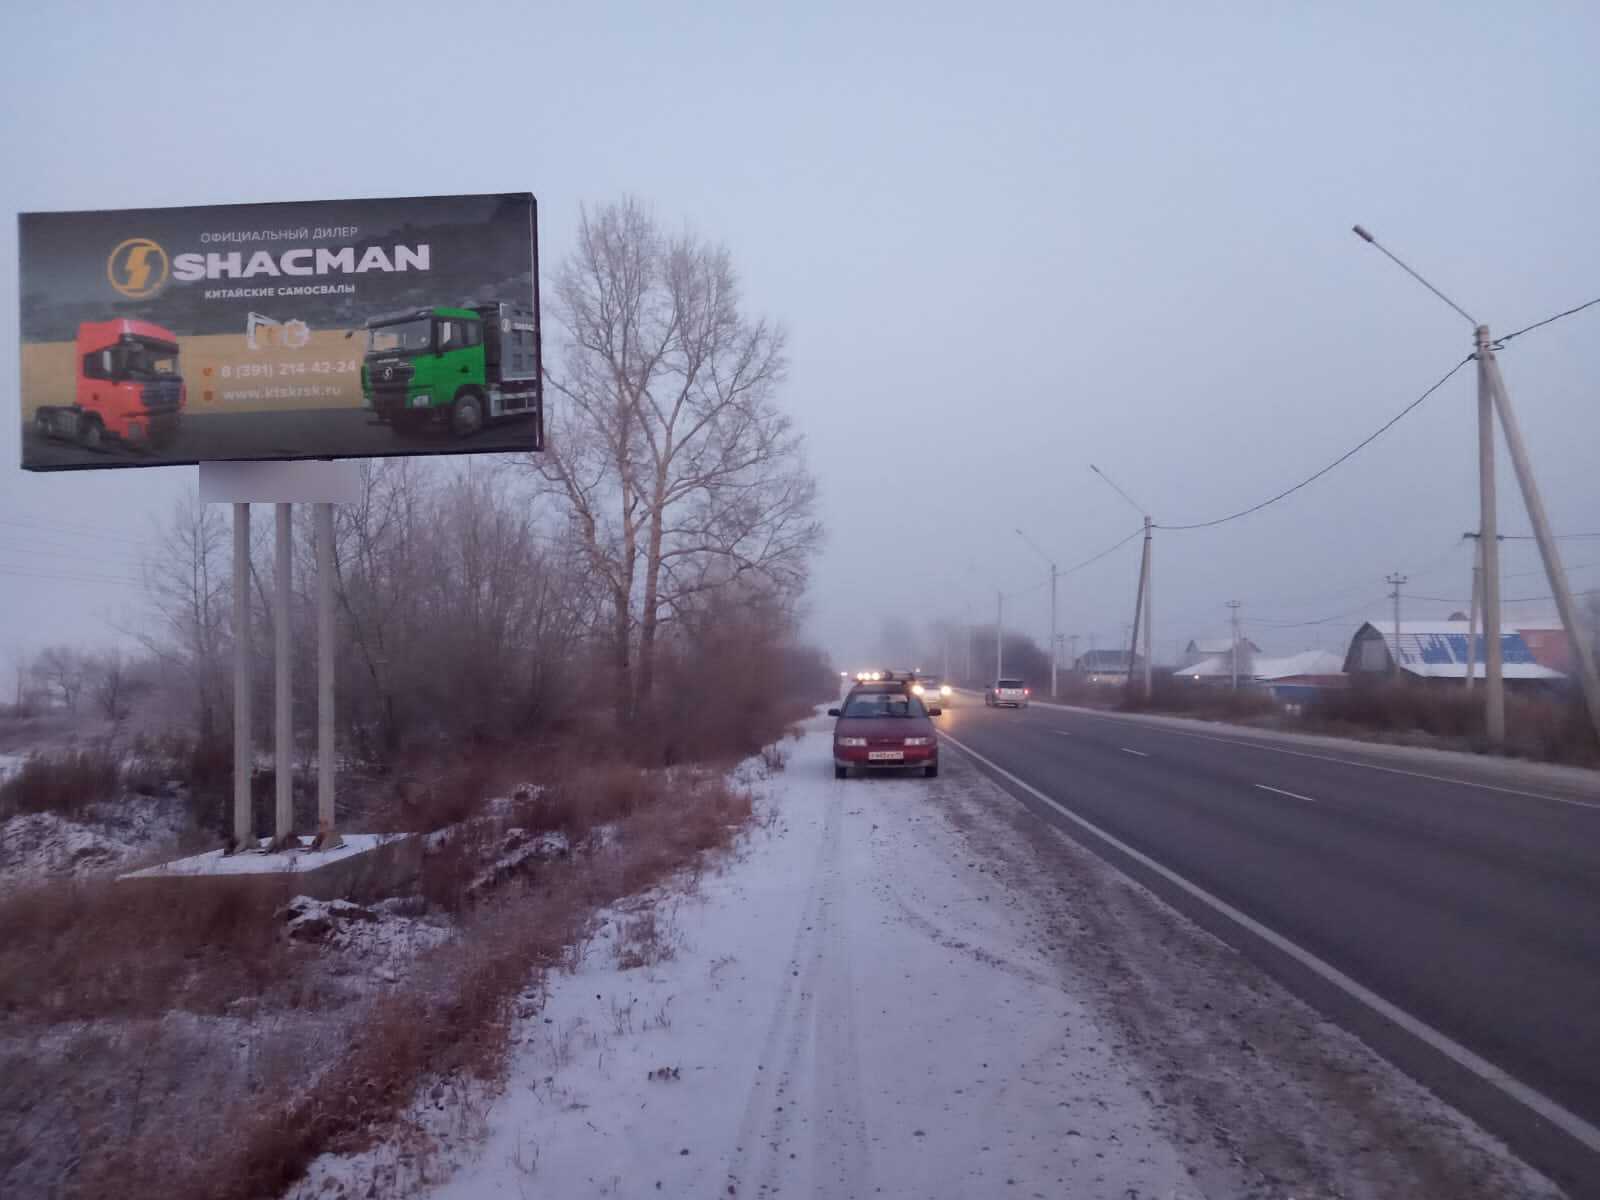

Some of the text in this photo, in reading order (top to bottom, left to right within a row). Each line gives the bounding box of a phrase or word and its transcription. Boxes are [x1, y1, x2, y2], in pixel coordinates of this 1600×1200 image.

[200, 225, 358, 243] ОФИЦИАЛЬНЫЙ ДИЛЕР
[173, 244, 431, 281] SHACMAN
[204, 284, 356, 299] КИТАЙСКИЕ САМОСВАЛЫ
